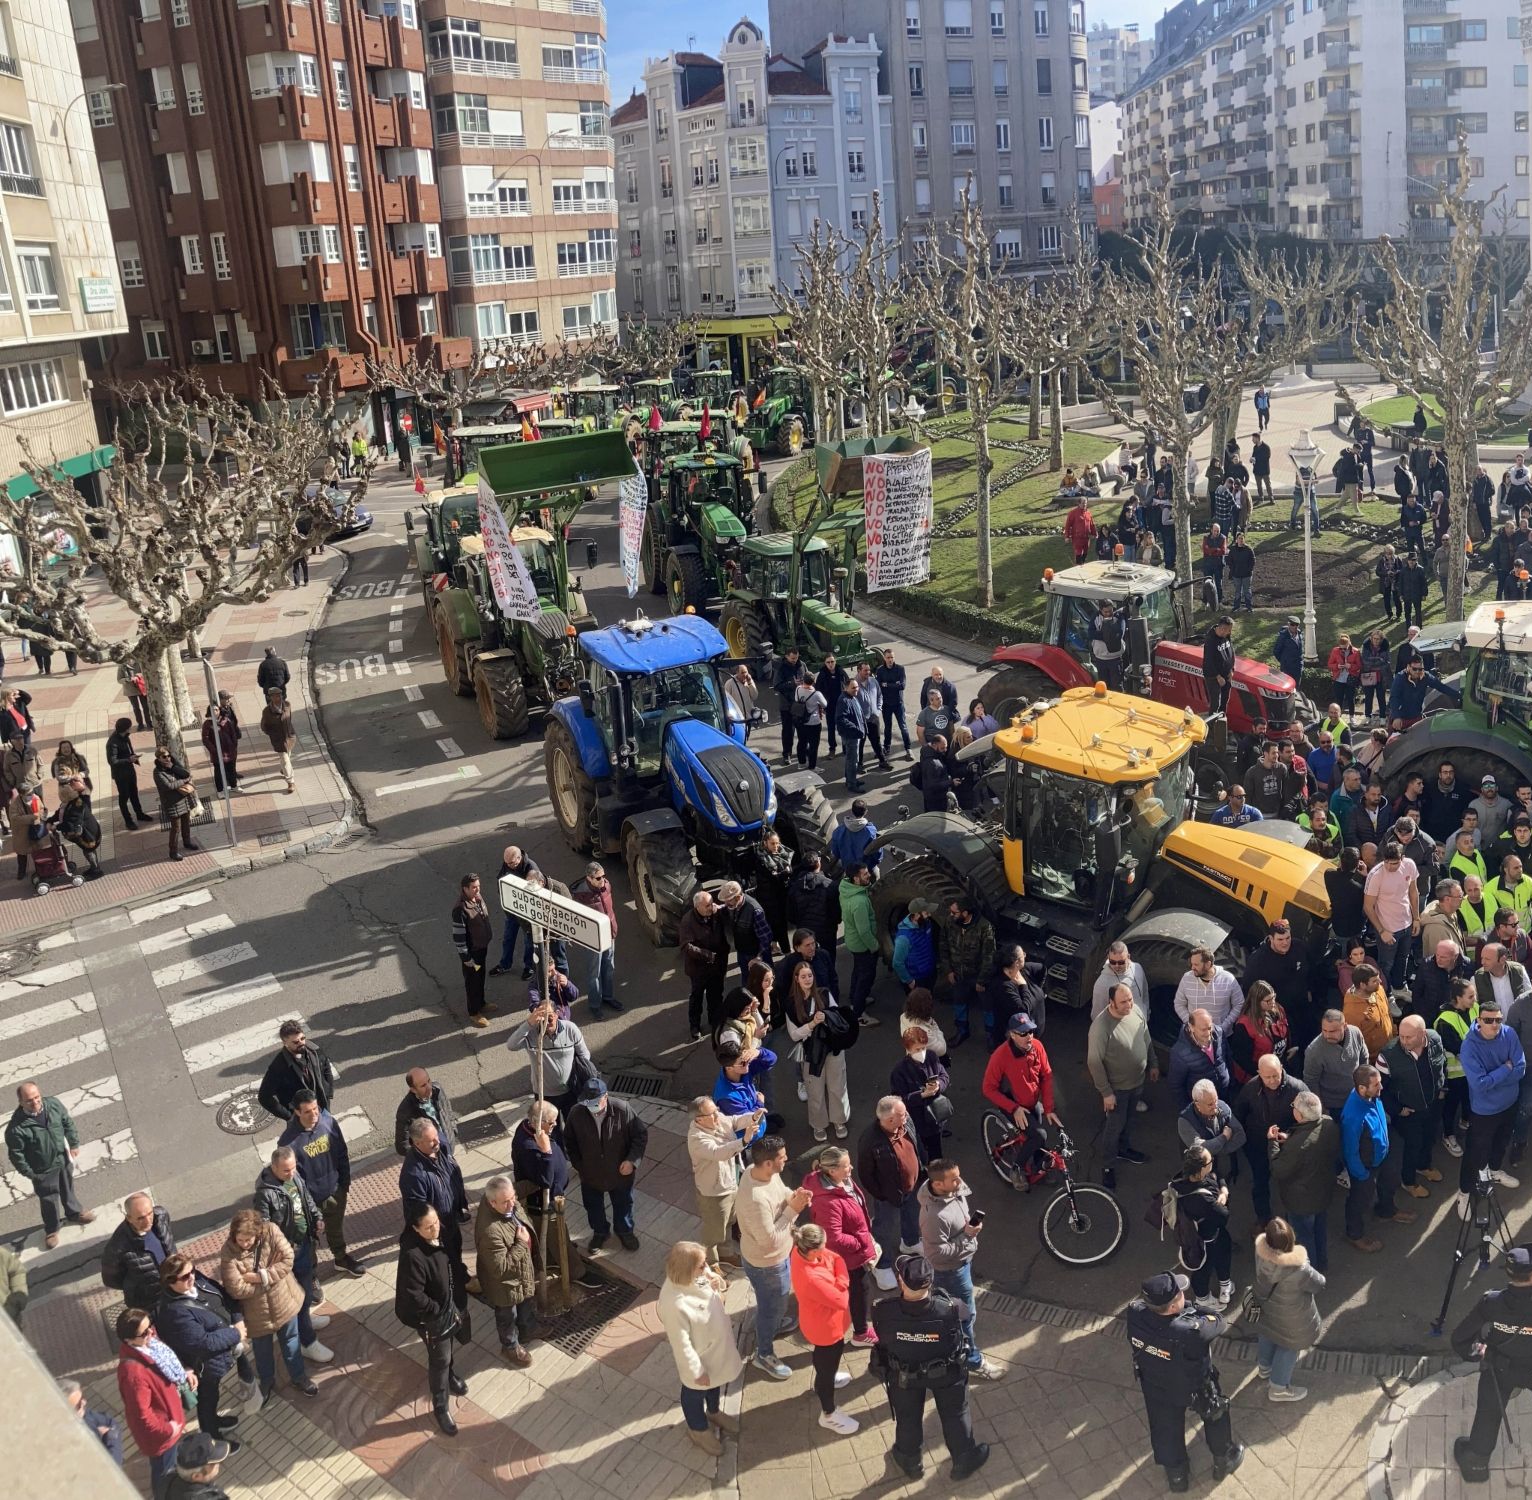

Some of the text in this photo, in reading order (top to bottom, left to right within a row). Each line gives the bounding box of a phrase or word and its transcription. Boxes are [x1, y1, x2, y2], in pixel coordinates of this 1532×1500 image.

[866, 462, 884, 474] NO
[866, 476, 886, 489] NO
[866, 489, 886, 502] NO
[866, 504, 884, 516] NO
[866, 519, 882, 530] NO
[868, 532, 882, 550] NO
[336, 580, 396, 600] BUS
[315, 654, 388, 685] BUS
[512, 890, 587, 929] subdelegación
[513, 900, 576, 936] del gobierno
